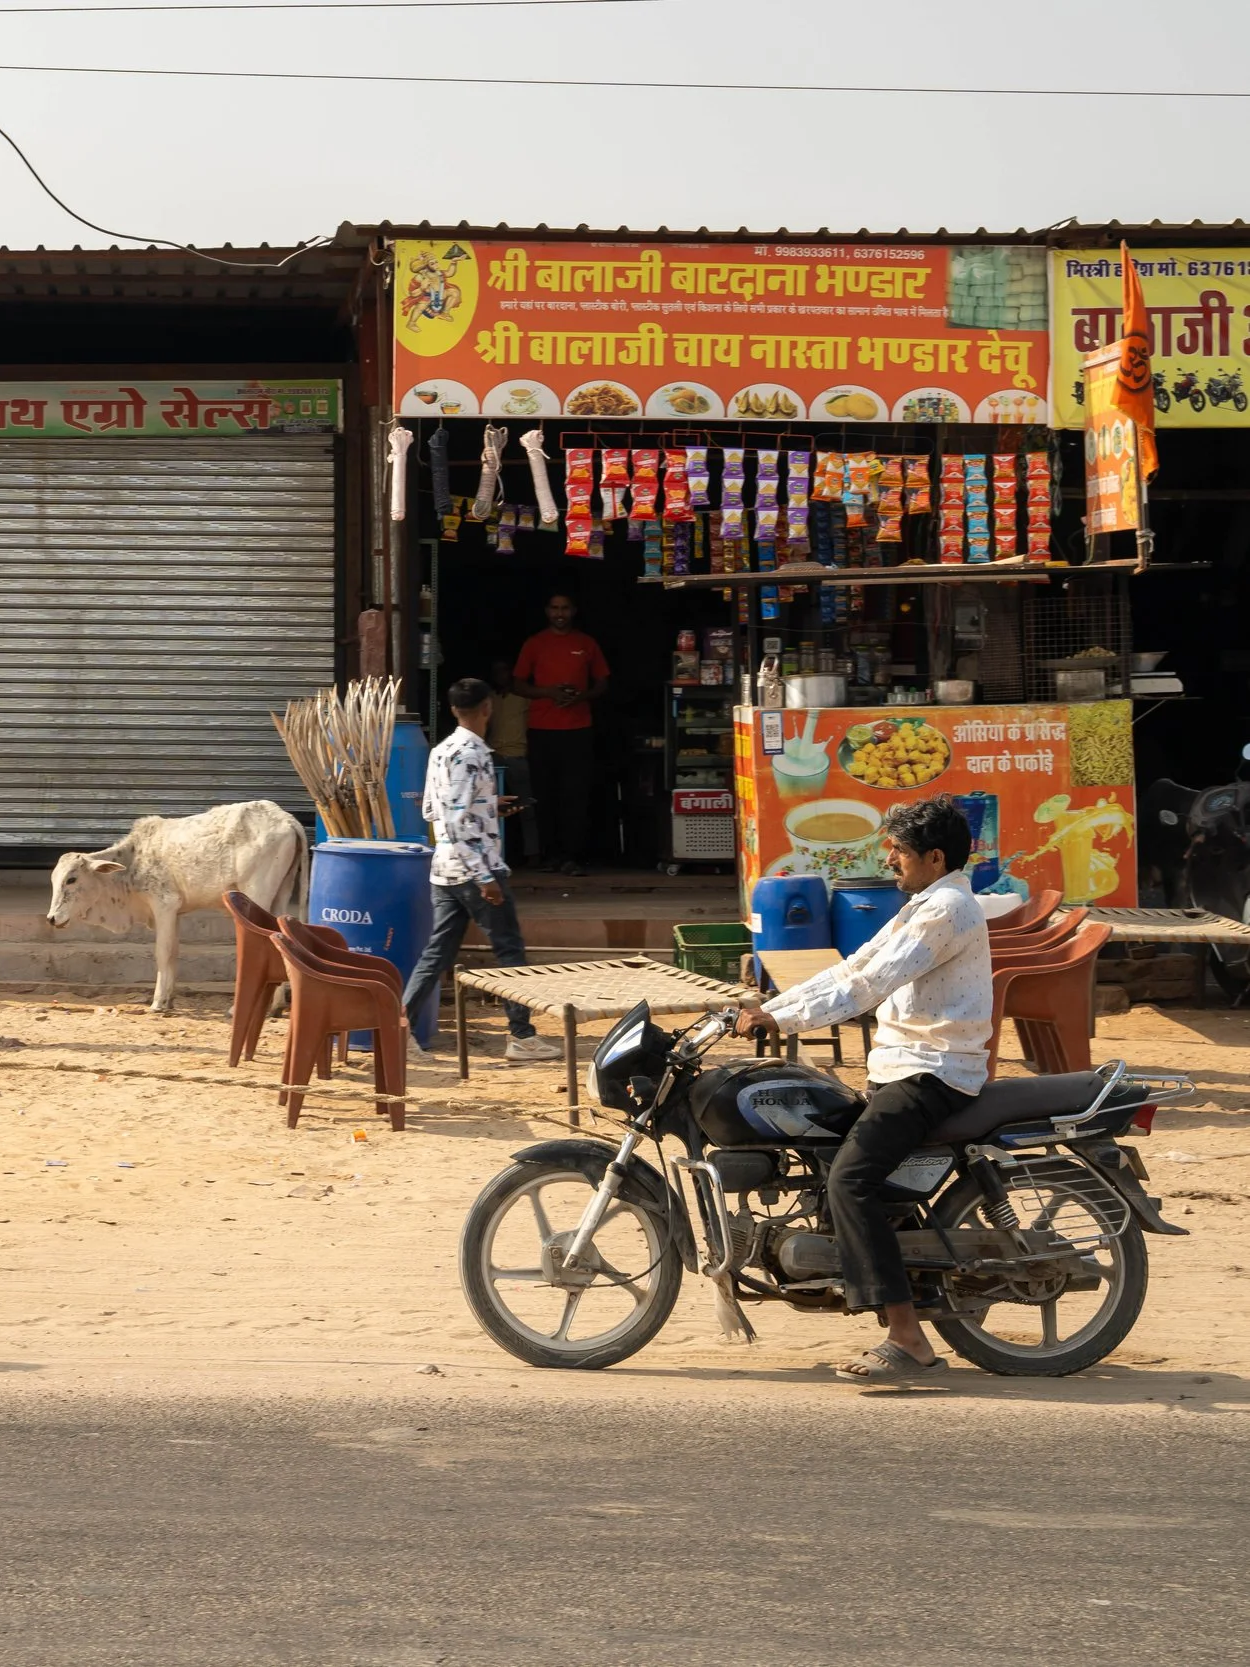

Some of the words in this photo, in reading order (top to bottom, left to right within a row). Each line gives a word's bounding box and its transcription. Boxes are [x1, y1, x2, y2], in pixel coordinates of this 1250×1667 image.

[853, 247, 925, 260] 6376152596
[486, 247, 530, 292] श्री
[534, 249, 665, 293] बालाजी
[669, 262, 810, 301] बारदाना
[815, 264, 932, 299] भण्डार
[1066, 259, 1111, 278] मिस्त्री
[534, 300, 546, 310] पर
[1071, 290, 1235, 357] बााजी
[474, 320, 524, 365] श्री
[528, 322, 668, 366] बालाजी
[672, 333, 744, 368] चाय
[749, 334, 852, 370] नास्ता
[857, 336, 972, 374] भण्डार
[977, 330, 1038, 388] देचू
[59, 387, 148, 433] एग्रो
[159, 387, 273, 430] सेल्स
[1006, 719, 1023, 741] के
[965, 755, 996, 774] दाल
[996, 750, 1012, 773] के
[321, 907, 373, 925] CRODA
